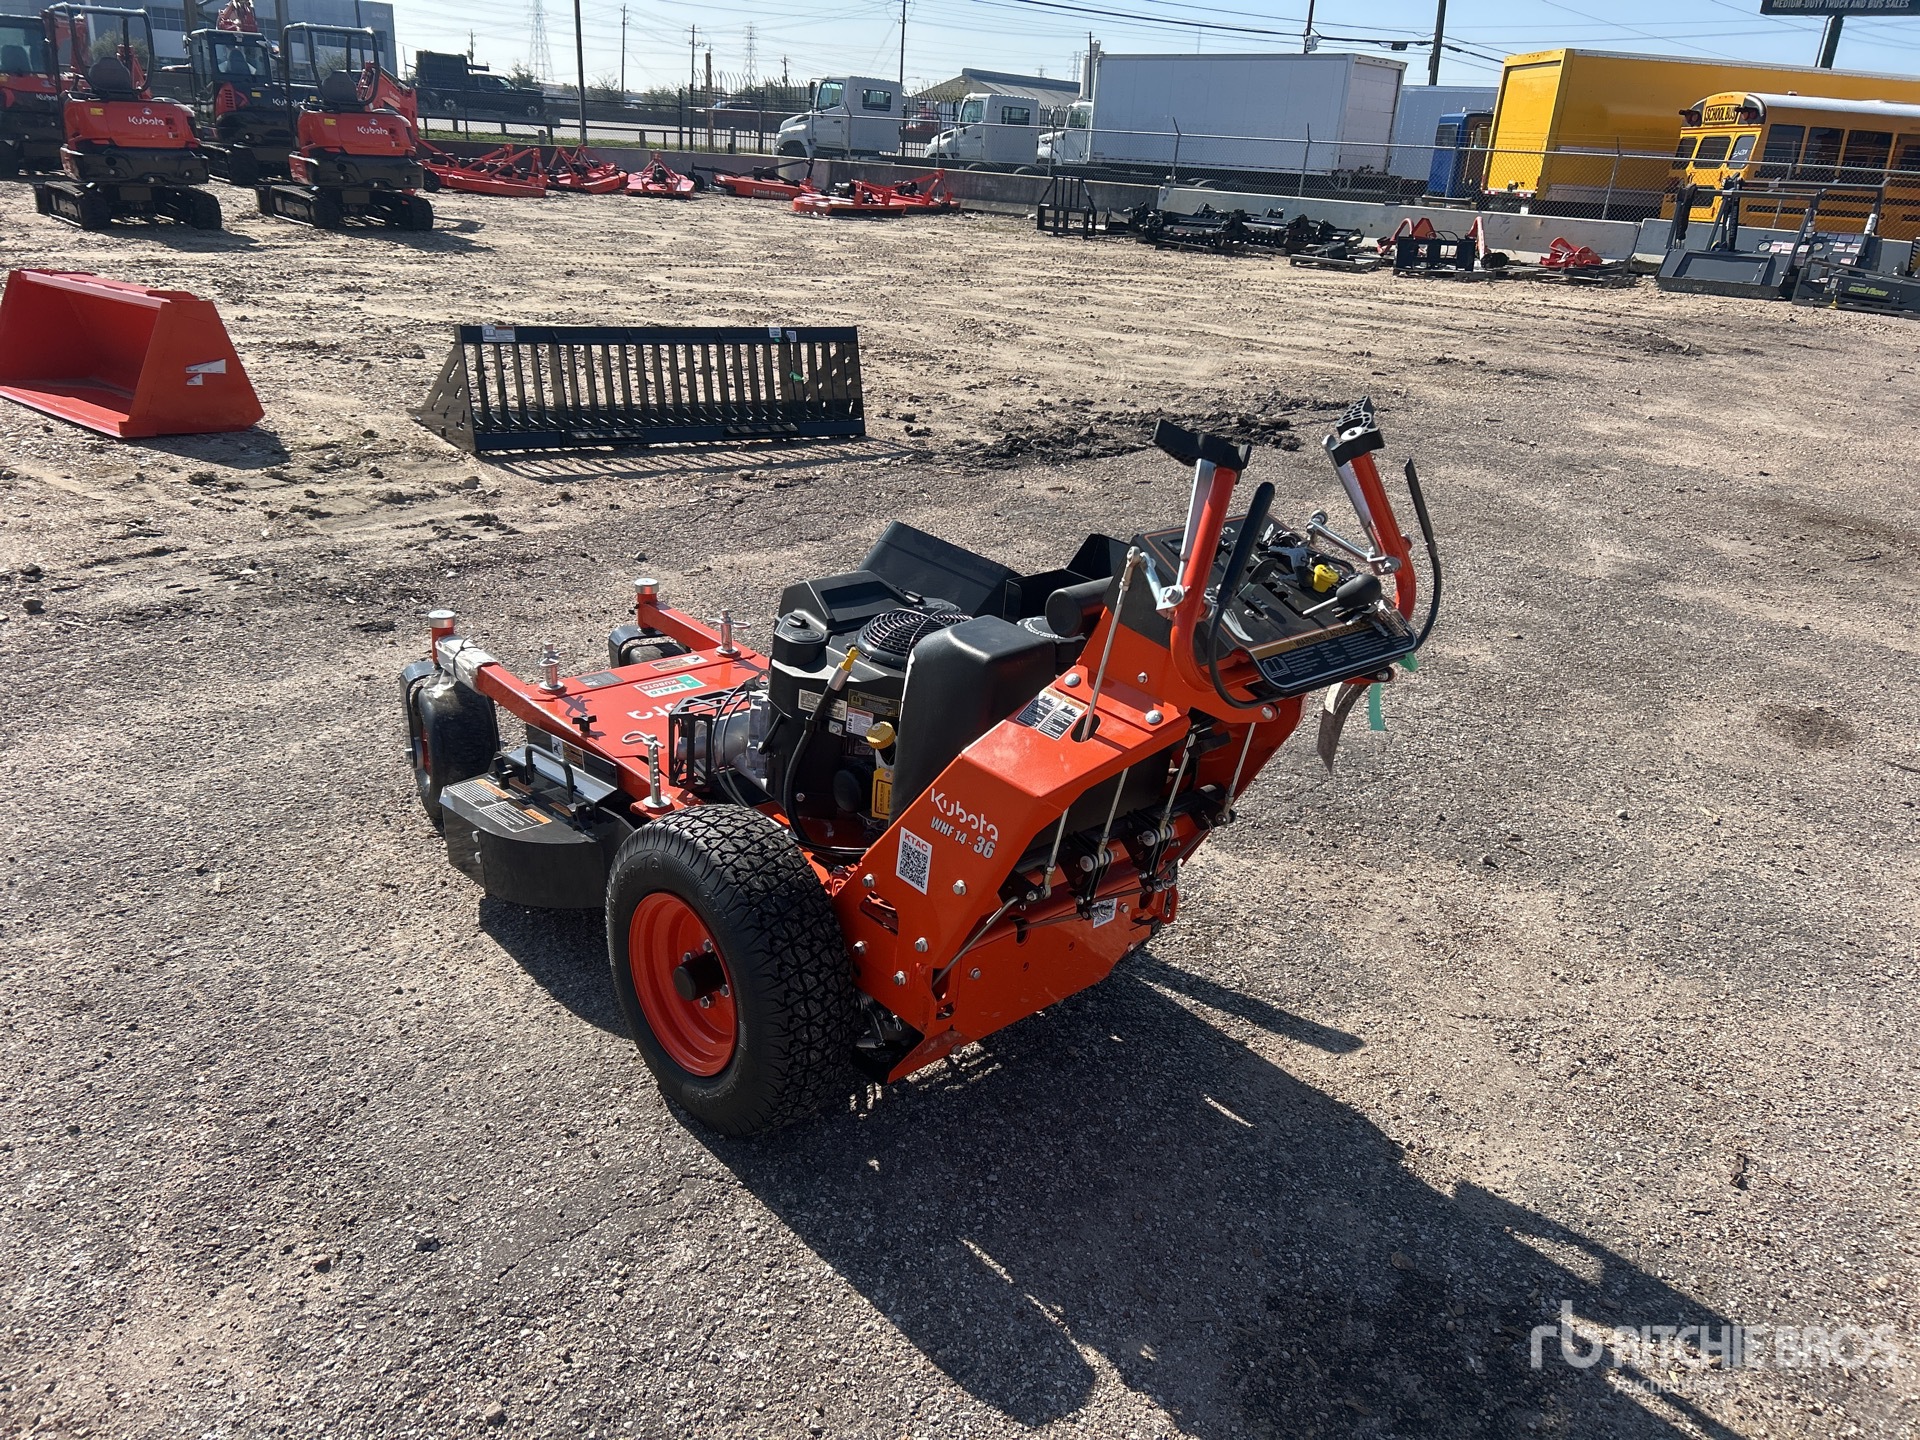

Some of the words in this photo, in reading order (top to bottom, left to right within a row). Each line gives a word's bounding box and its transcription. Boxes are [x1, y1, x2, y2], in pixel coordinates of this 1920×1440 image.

[1772, 0, 1824, 8] MEDIUM-DUTY
[1825, 0, 1849, 8] TRUCK
[1849, 0, 1867, 8] AND
[1867, 0, 1884, 8] BUS
[1885, 0, 1910, 8] SALES
[1706, 107, 1726, 121] SCHOOL
[128, 115, 165, 126] Kubota
[357, 126, 389, 136] Kubota
[753, 188, 770, 196] Land
[770, 190, 790, 198] Pride
[1849, 286, 1869, 294] cool
[1867, 287, 1888, 297] flow
[1296, 631, 1327, 648] WARNING
[641, 679, 677, 690] KUBOTA
[650, 684, 686, 695] EWALD
[931, 788, 998, 841] Kubota
[904, 833, 928, 853] KTAC
[931, 816, 954, 837] WHF
[954, 830, 967, 845] 14
[973, 836, 996, 859] 36
